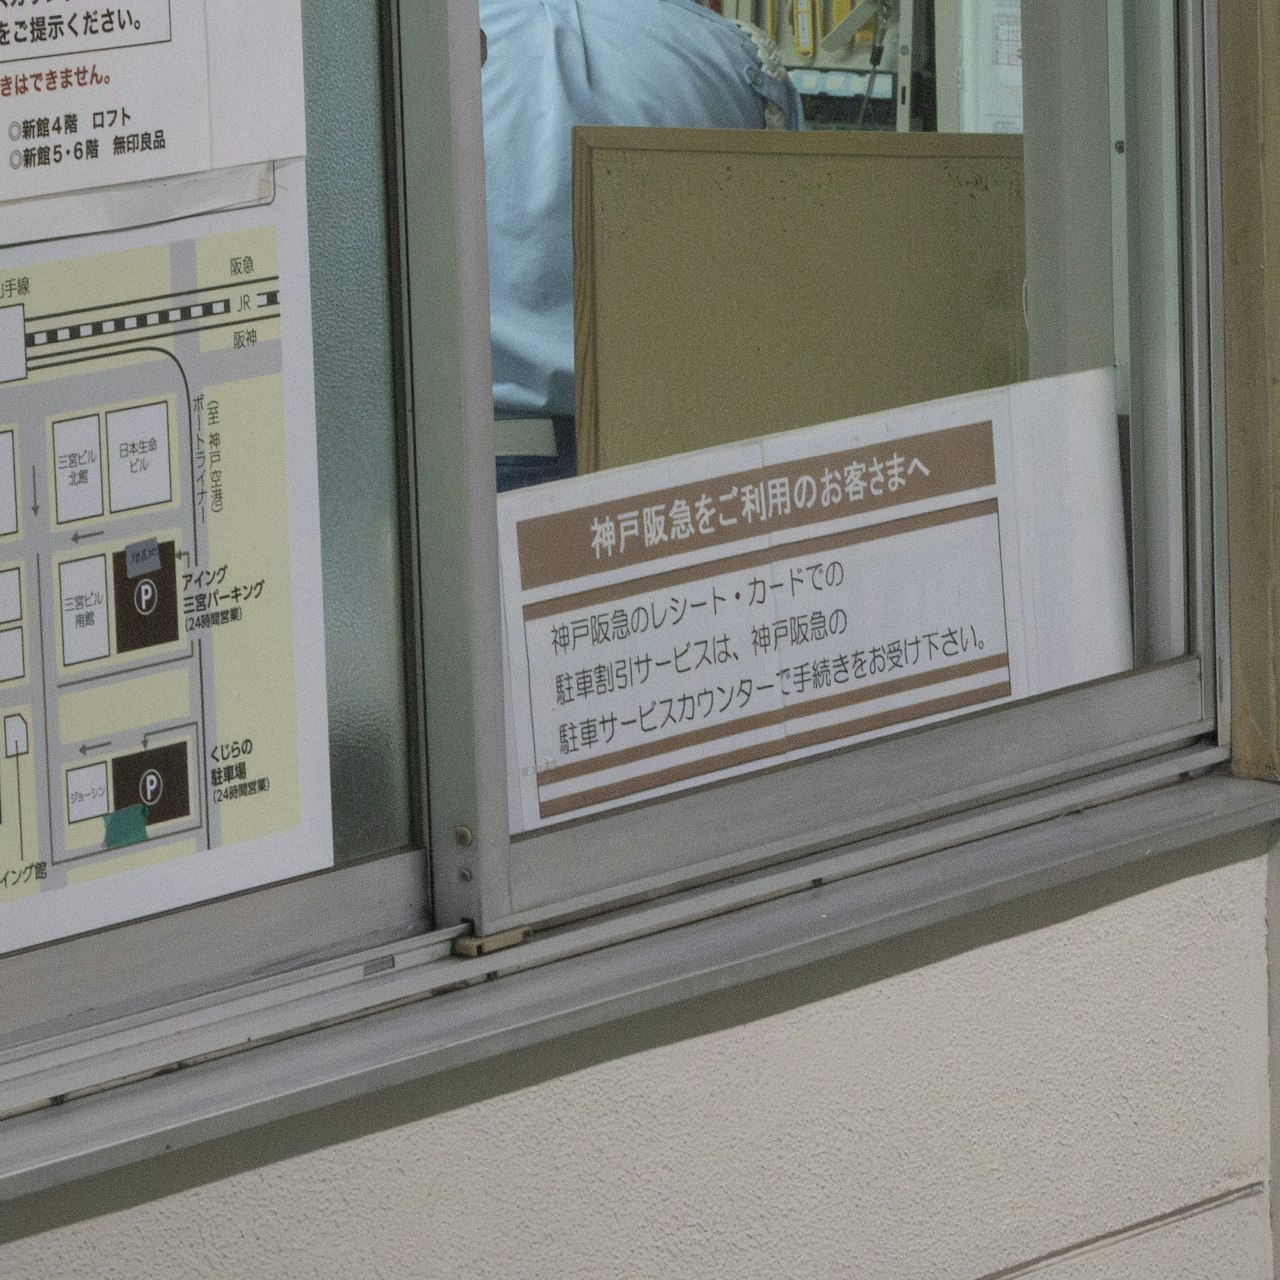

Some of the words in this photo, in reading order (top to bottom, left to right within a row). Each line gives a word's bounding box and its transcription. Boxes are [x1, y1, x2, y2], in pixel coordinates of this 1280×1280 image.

[0, 64, 111, 97] きはできません。
[113, 130, 166, 156] 無印良品
[230, 255, 254, 276] 阪急
[237, 293, 251, 312] JR
[233, 328, 257, 349] 阪神
[58, 449, 97, 470] 三宮ビル
[119, 437, 158, 458] 日本生命
[130, 457, 149, 473] ビル
[591, 452, 930, 559] 神戸阪急をご利用のお客さまへ
[182, 564, 228, 592] アイング
[183, 579, 265, 615] 三宮パーキング
[551, 561, 844, 656] 神戸阪急のレシート・カードでの
[558, 624, 985, 755] 駐車サービスカウンターで手続きをお受け下さい。
[211, 738, 253, 762] くじらの
[210, 761, 247, 787] 駐車場
